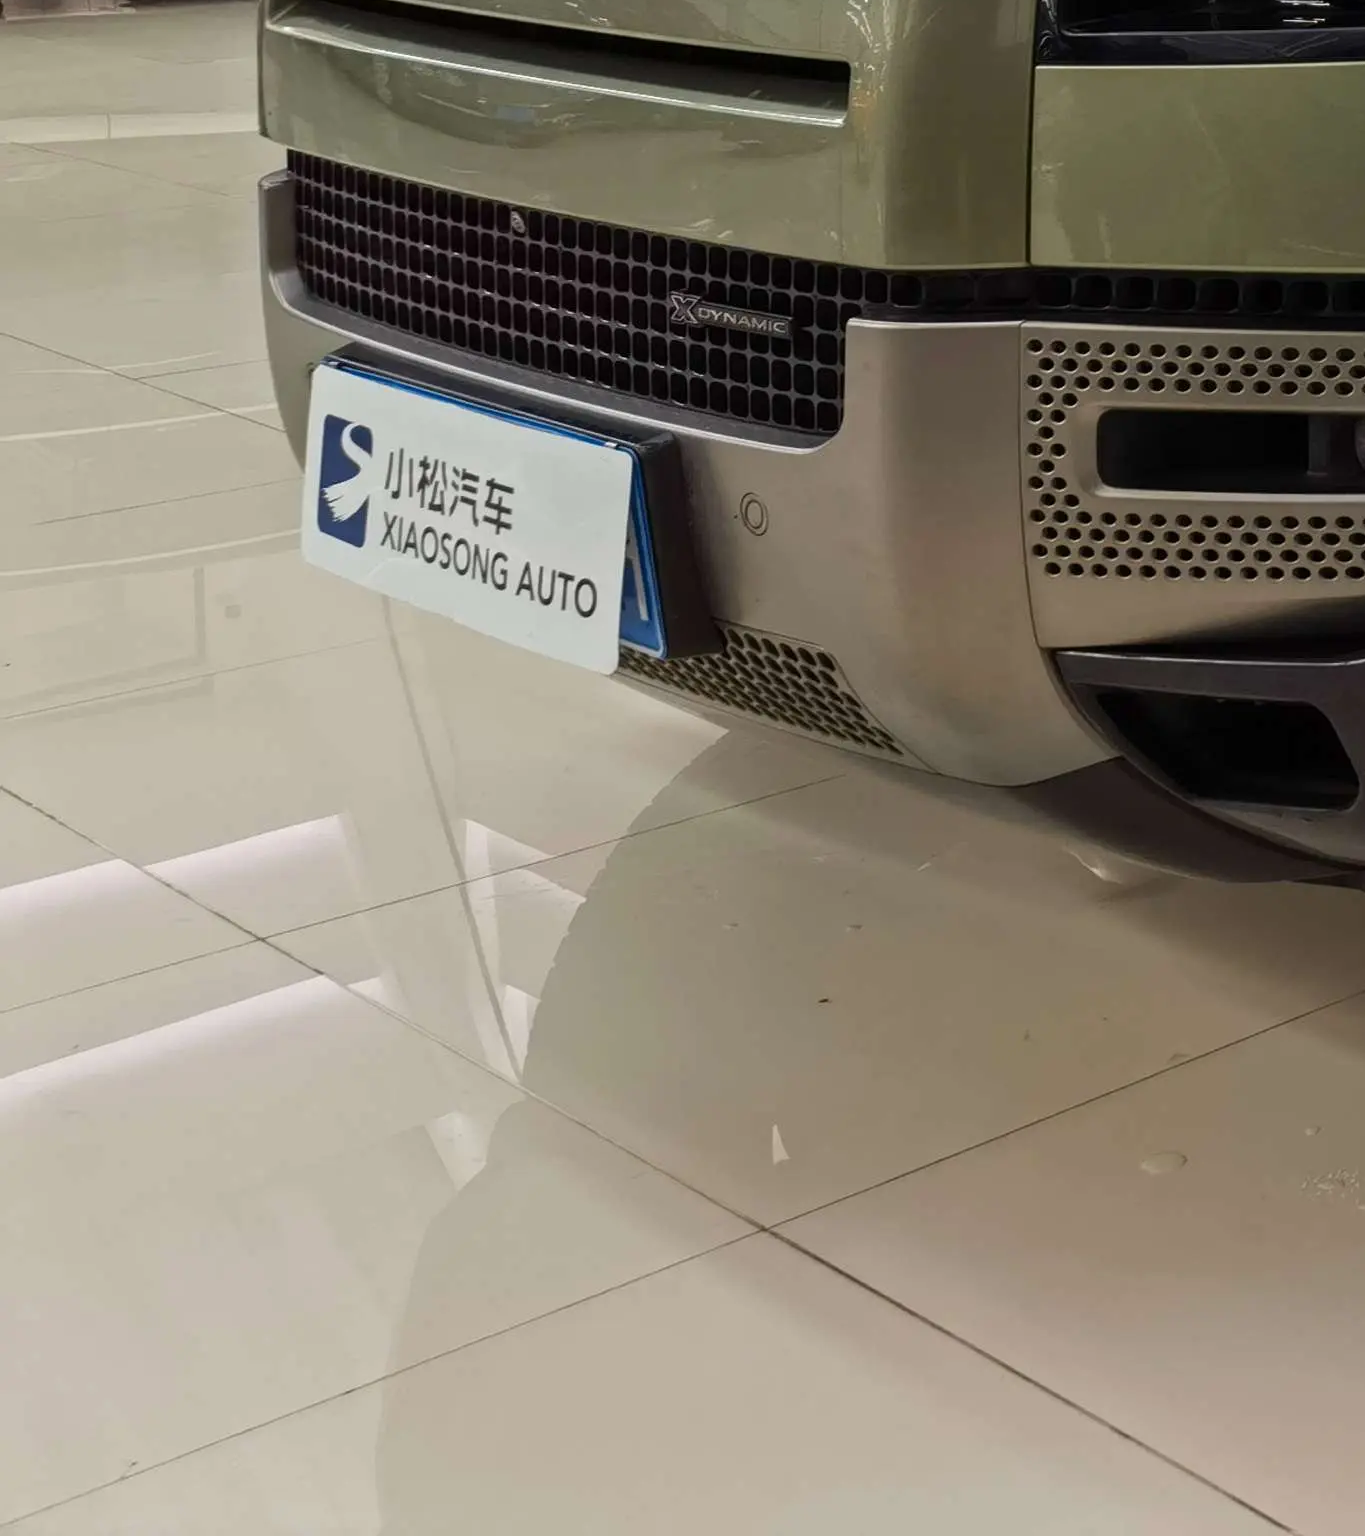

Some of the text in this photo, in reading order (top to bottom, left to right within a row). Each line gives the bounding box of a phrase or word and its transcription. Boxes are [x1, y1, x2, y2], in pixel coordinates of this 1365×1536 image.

[384, 447, 516, 536] 小松汽车
[379, 510, 509, 592] XIAOSONG
[515, 563, 599, 620] AUTO
